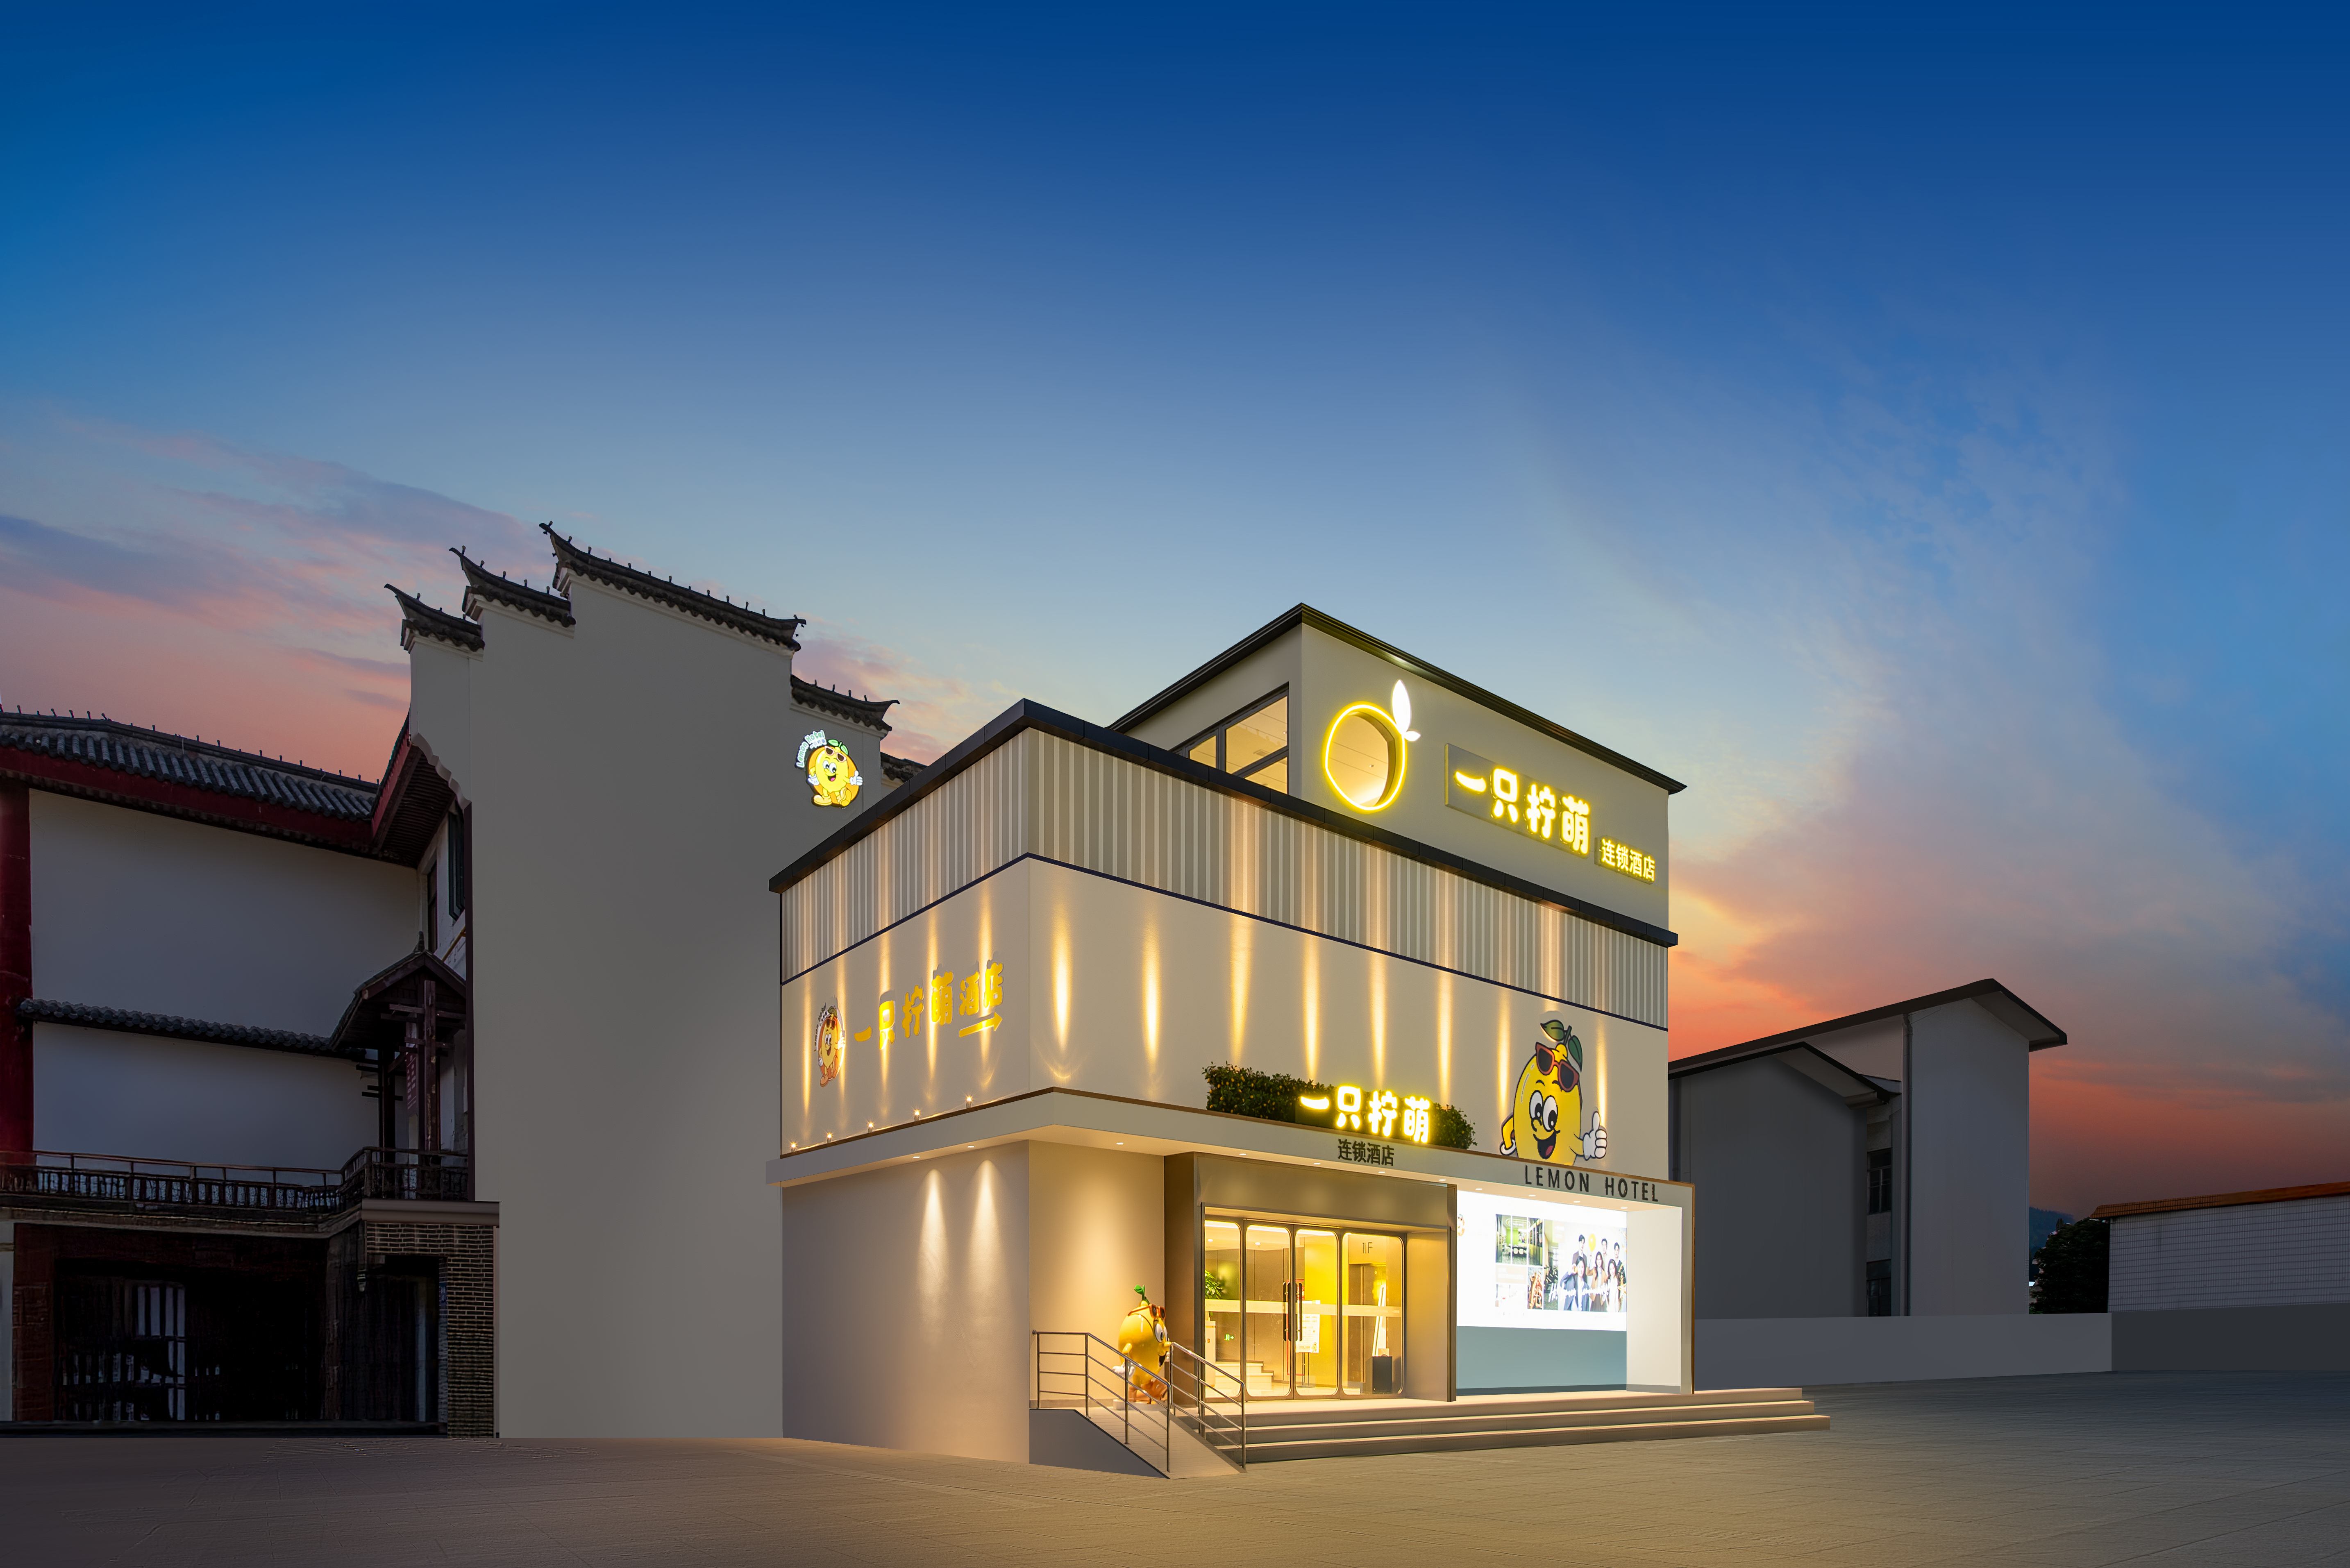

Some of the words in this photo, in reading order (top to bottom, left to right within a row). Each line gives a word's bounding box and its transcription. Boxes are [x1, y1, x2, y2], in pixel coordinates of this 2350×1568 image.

[796, 741, 808, 767] Lemon
[805, 730, 825, 744] Hotel
[1454, 768, 1590, 854] 一只柠萌
[1601, 839, 1655, 881] 连锁酒店
[854, 962, 1004, 1049] 一只柠萌酒店
[1300, 1086, 1430, 1143] 一只柠萌
[1338, 1139, 1394, 1166] 连锁酒店
[1524, 1164, 1589, 1193] LEMON
[1605, 1177, 1659, 1202] HOTEL
[1362, 1242, 1374, 1254] 1F
